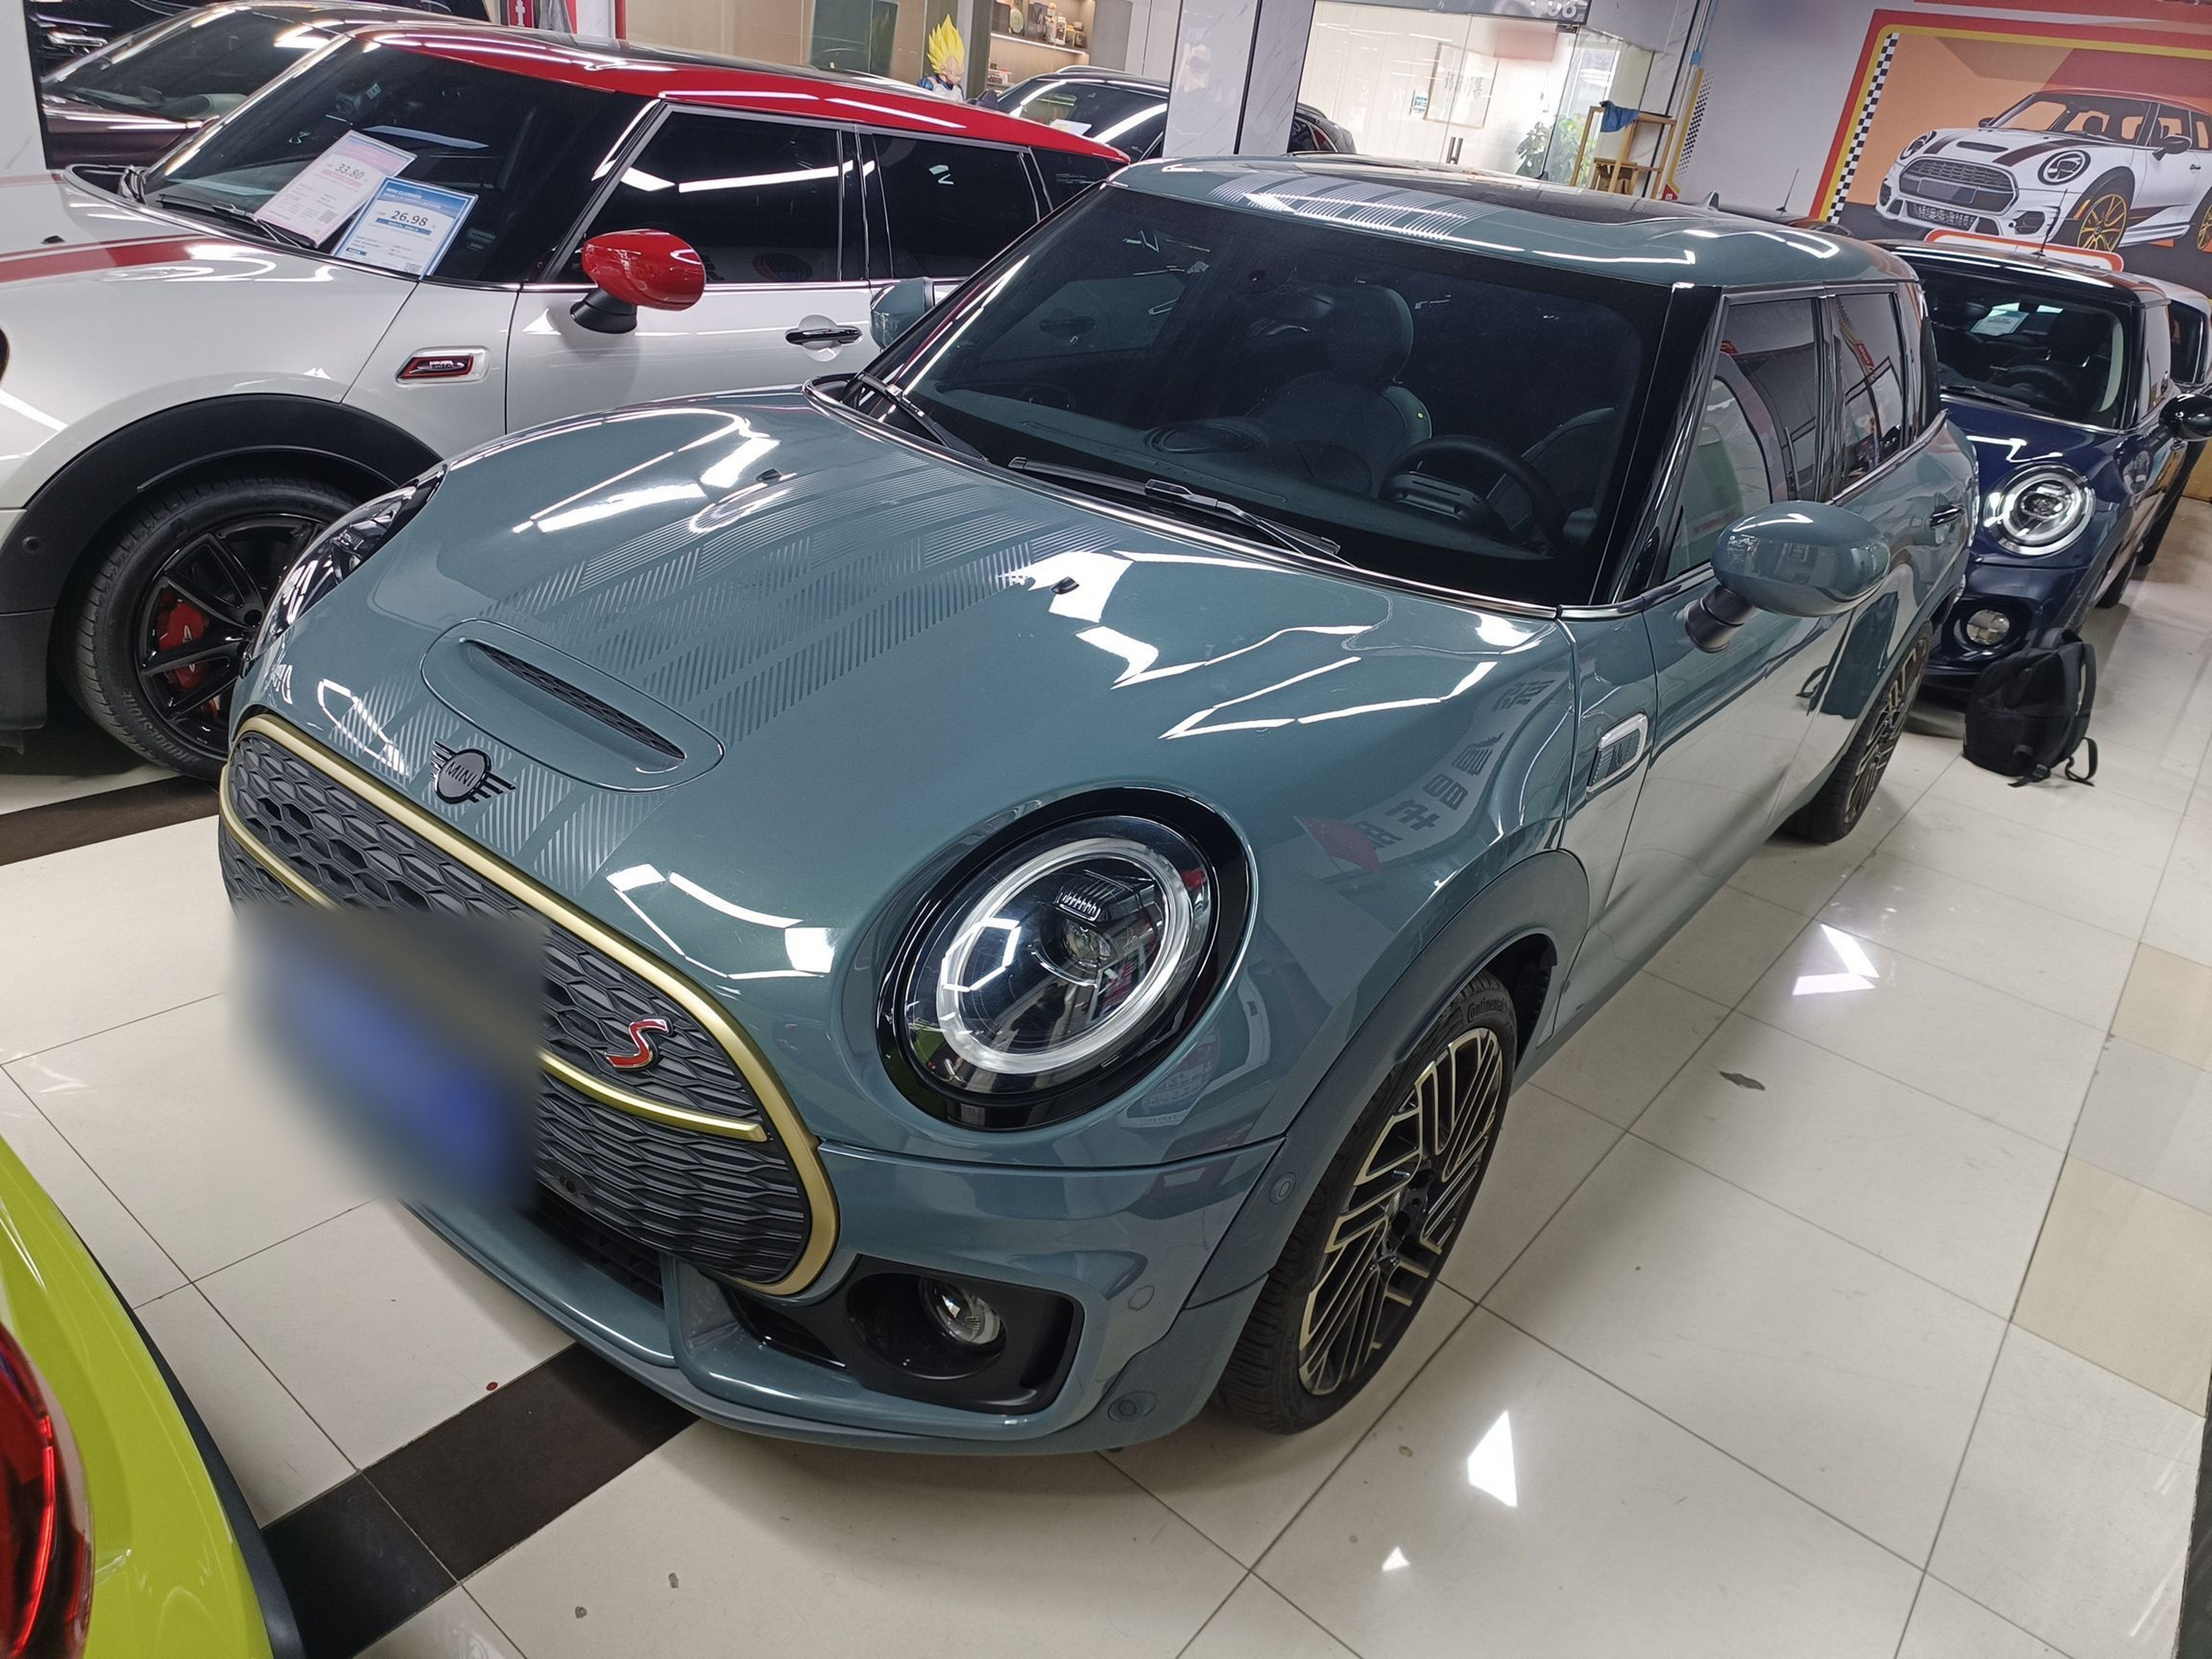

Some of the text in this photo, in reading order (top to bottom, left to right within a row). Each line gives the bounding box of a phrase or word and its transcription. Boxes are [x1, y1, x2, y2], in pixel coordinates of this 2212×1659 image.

[391, 210, 429, 227] 26.98
[445, 762, 478, 787] MINI
[603, 1018, 669, 1070] S
